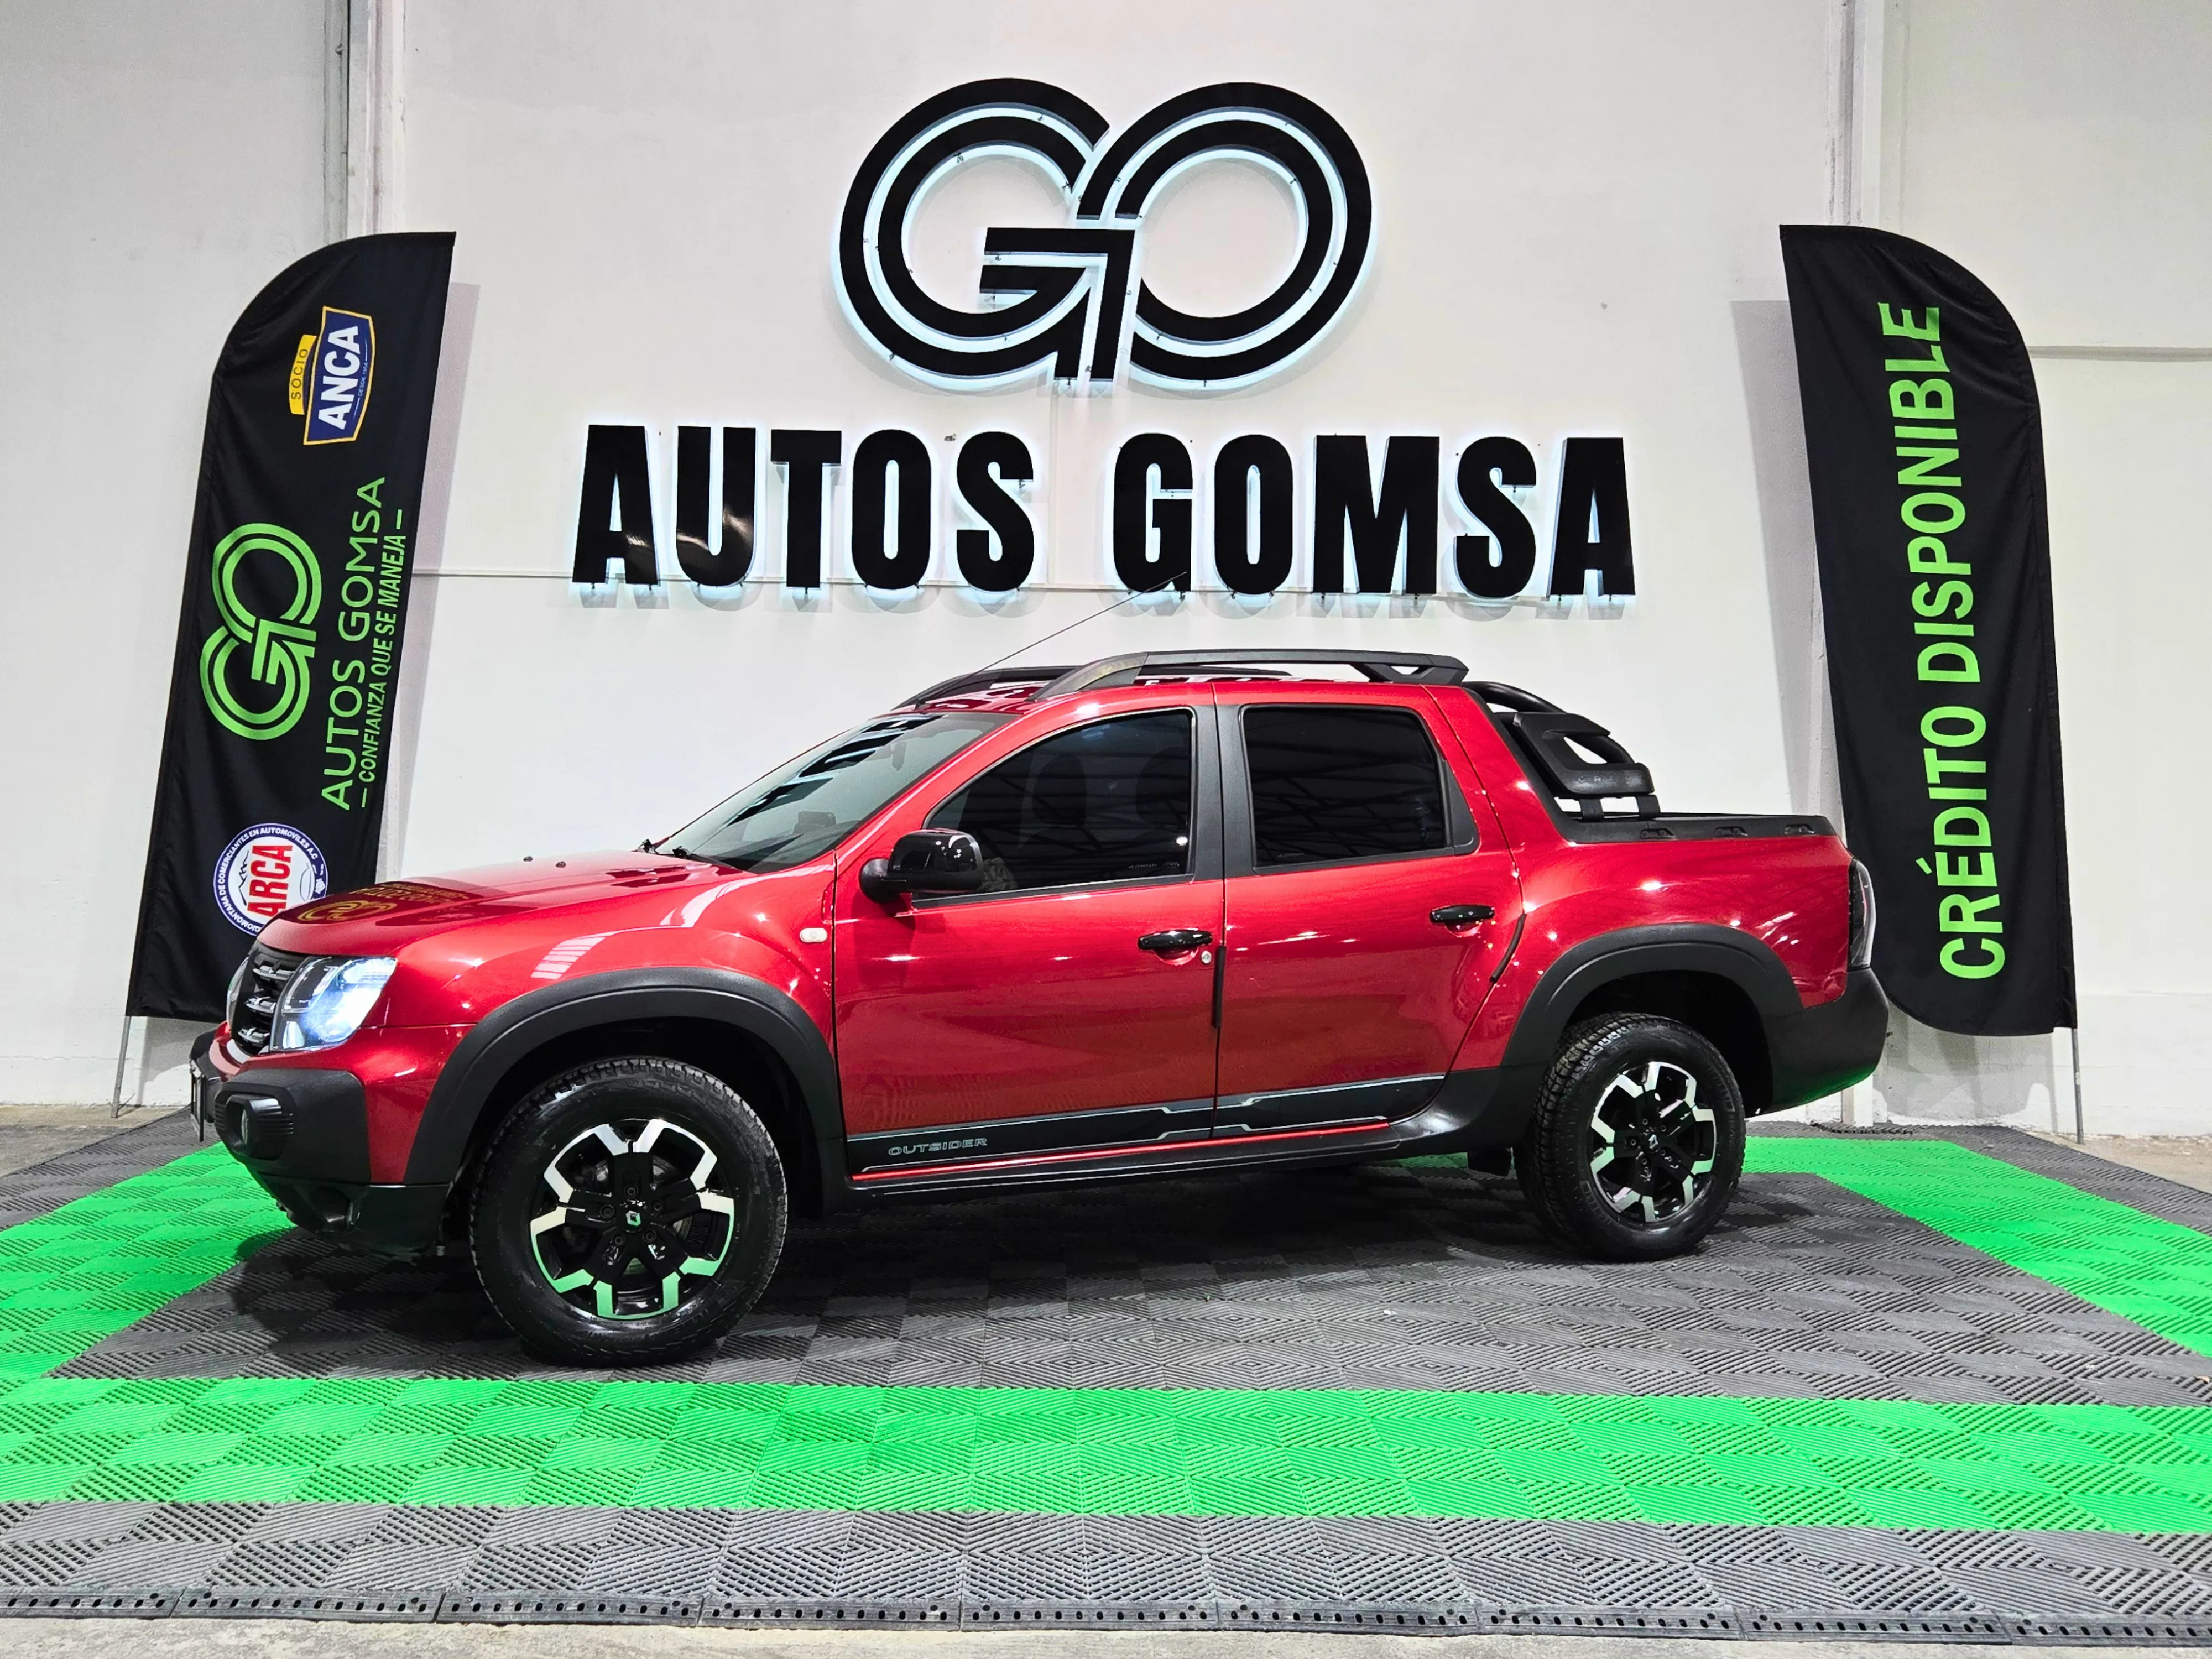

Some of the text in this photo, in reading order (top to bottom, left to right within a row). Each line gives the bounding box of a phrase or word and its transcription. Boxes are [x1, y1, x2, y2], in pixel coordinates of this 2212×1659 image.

[839, 77, 1371, 380] GO
[291, 348, 308, 400] SOCIO
[318, 326, 361, 430] ANCA
[572, 424, 1636, 598] AUTOS GOMSA
[200, 523, 322, 740] GO
[321, 477, 385, 810] AUTOS GOMSA
[359, 535, 406, 782] CONFIANZA QUE SE MANEJA
[1877, 302, 2005, 979] CRÉDITO DISPONIBLE
[218, 833, 249, 884] COMERCIANTES
[249, 828, 259, 837] EN
[260, 827, 310, 849] AUTOMOVILES
[218, 885, 226, 896] DE
[221, 895, 262, 933] GIOMONTANA
[247, 845, 293, 917] ARCA
[888, 1138, 987, 1156] OUTSIDER
